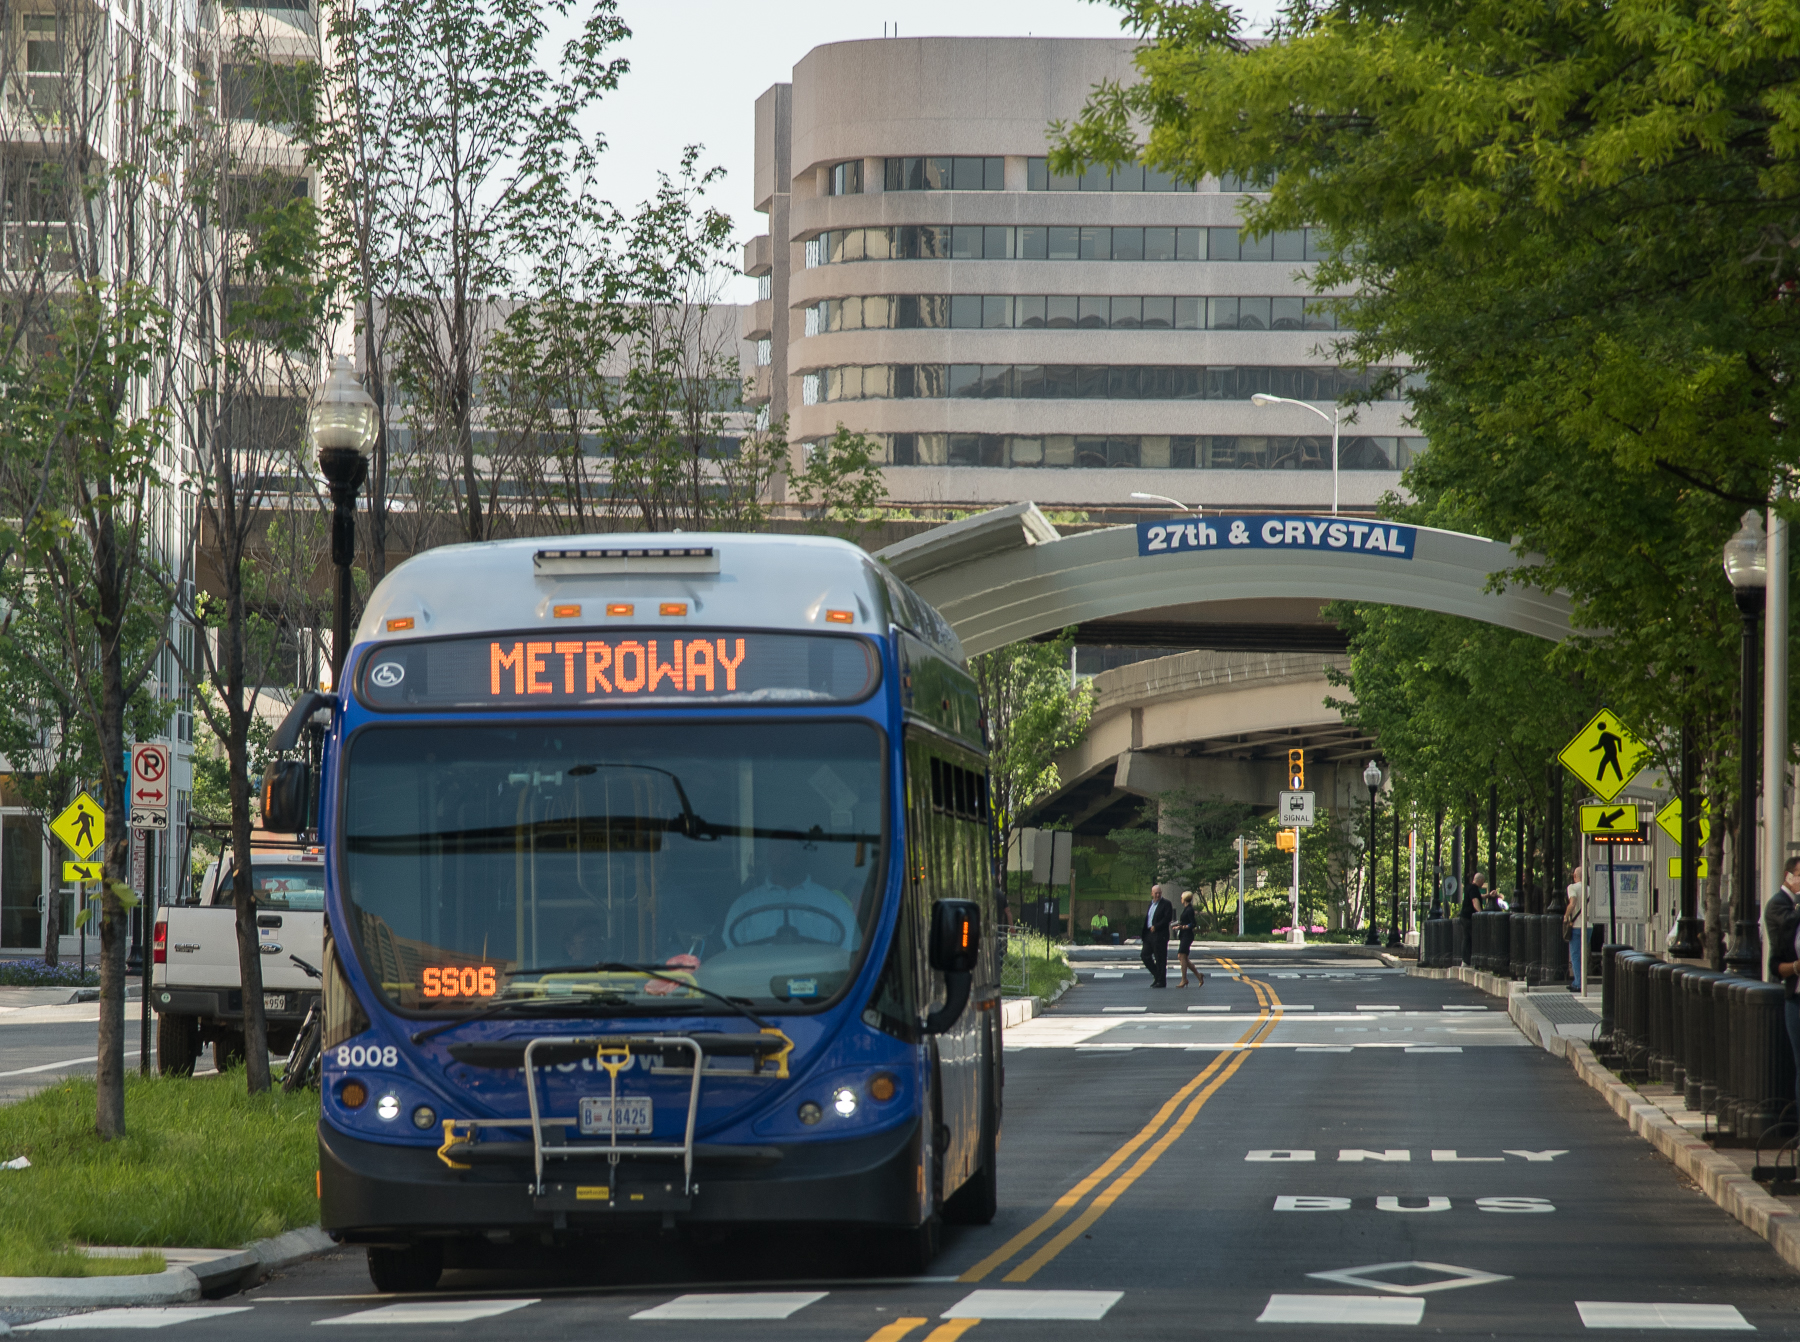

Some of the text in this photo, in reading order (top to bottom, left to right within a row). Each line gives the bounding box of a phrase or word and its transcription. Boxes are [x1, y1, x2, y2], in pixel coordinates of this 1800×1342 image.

[1147, 520, 1406, 553] 27th & CRYSTAL
[490, 638, 746, 695] METROWAY
[1283, 814, 1310, 822] SIGNAL
[337, 1045, 398, 1067] 8008
[585, 1108, 592, 1125] B
[1244, 1149, 1570, 1161] ONLY
[1272, 1195, 1557, 1213] BUS
